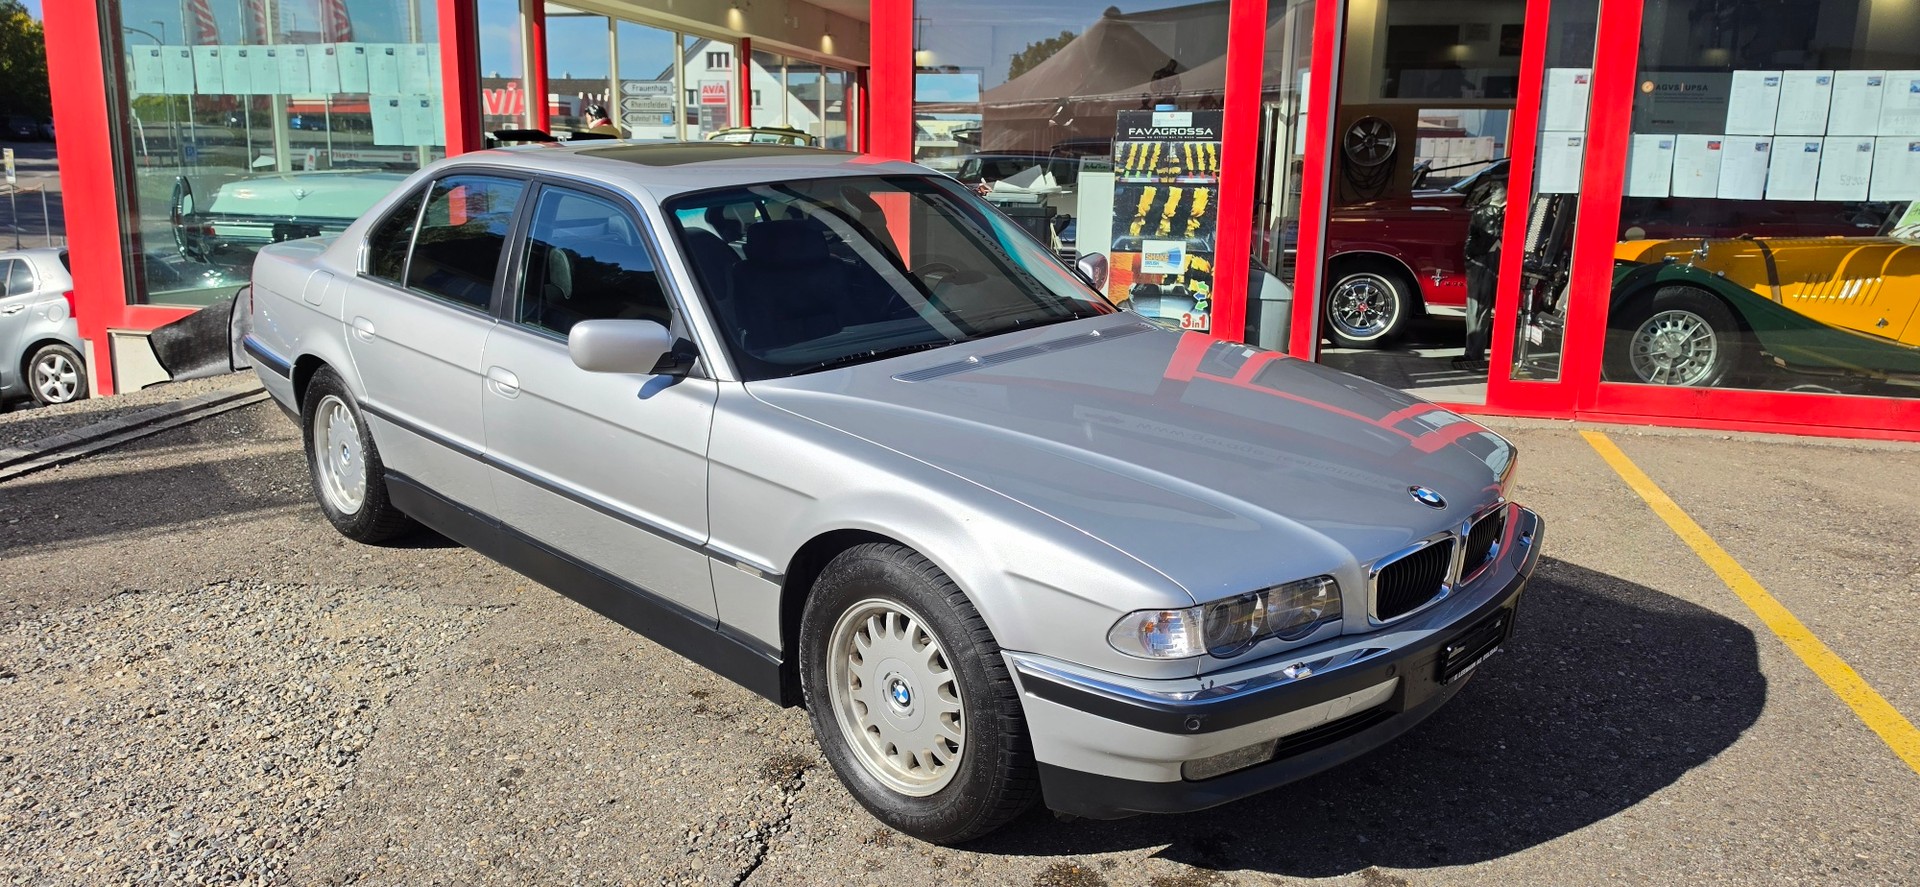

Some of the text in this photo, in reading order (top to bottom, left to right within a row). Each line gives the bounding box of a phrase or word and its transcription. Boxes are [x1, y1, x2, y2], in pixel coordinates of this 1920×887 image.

[631, 84, 668, 94] Frauenhag
[702, 82, 725, 94] AVIA
[1128, 128, 1214, 136] FAVAGROSSA
